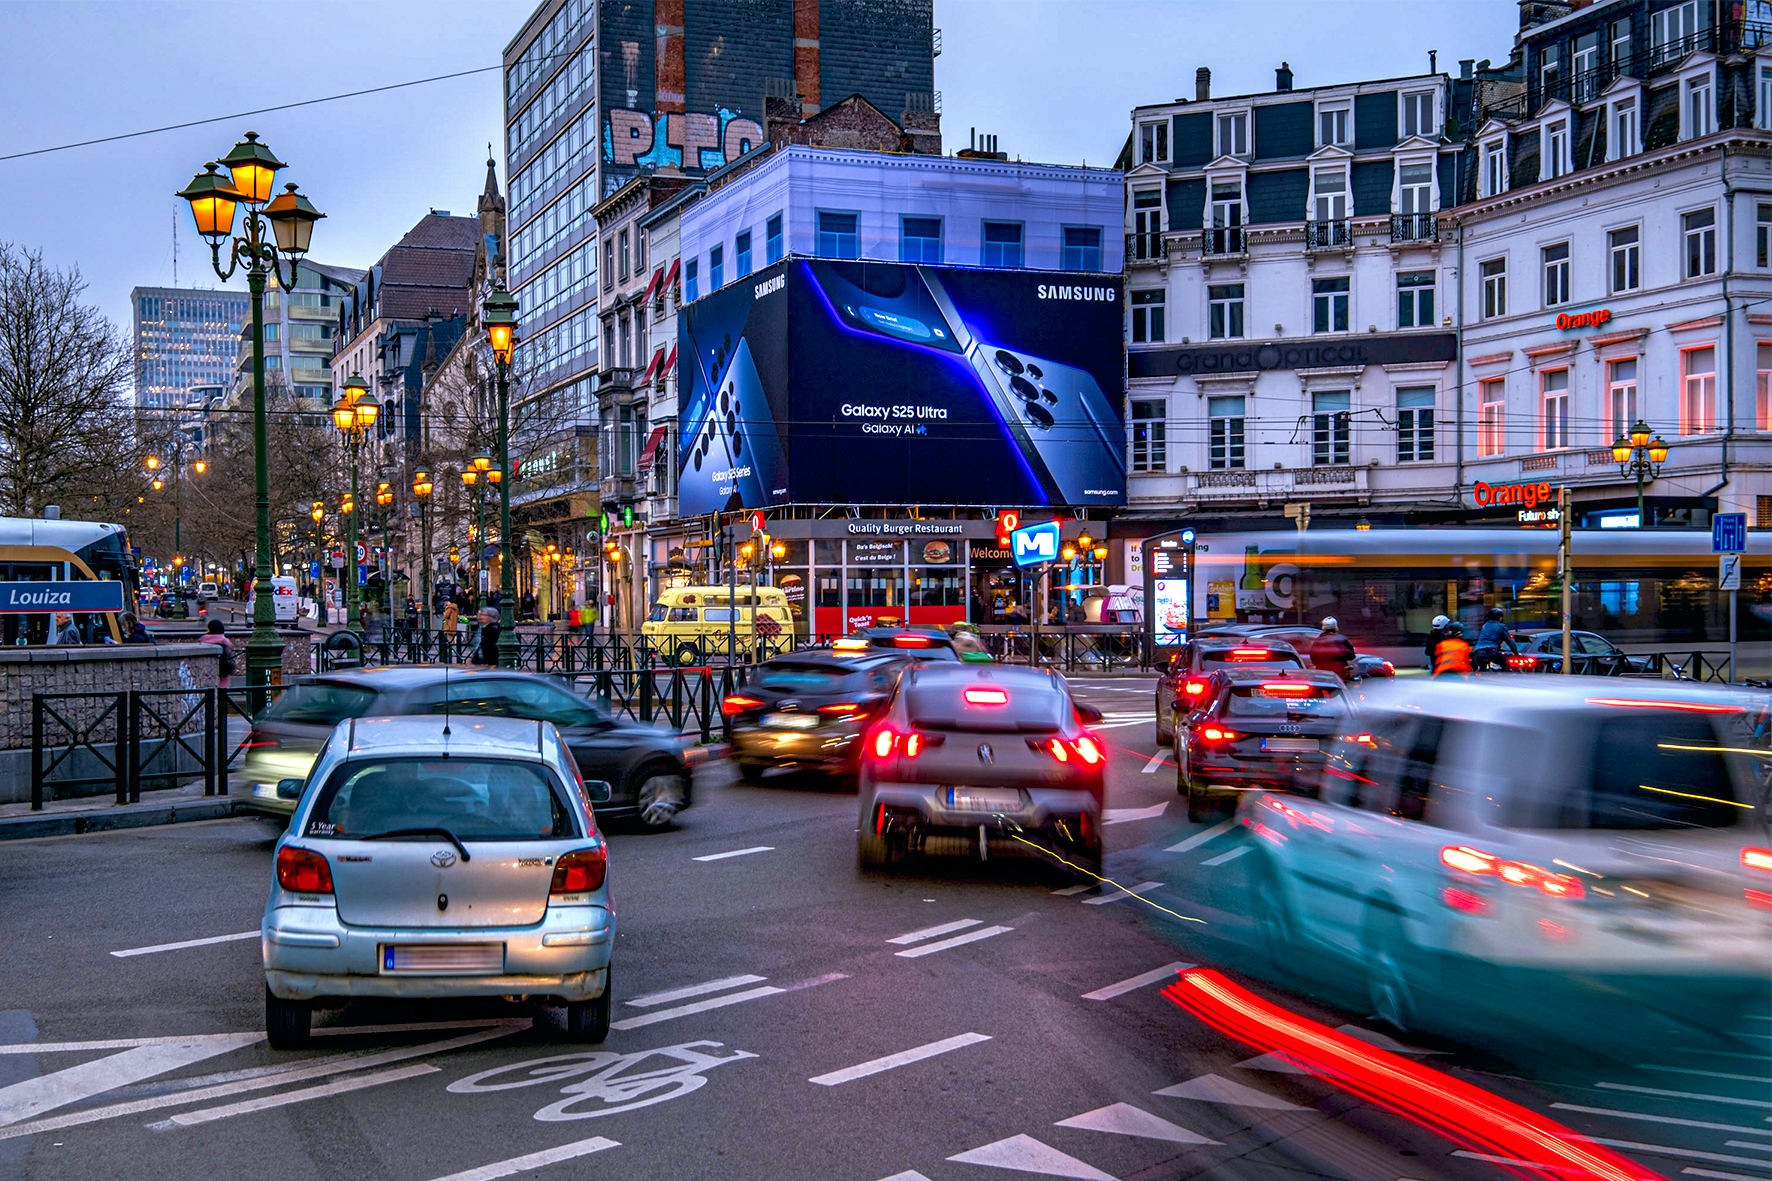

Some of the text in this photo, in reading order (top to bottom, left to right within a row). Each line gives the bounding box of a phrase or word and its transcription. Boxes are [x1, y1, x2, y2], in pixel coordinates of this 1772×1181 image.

[755, 273, 785, 300] SAMSUNG
[1037, 284, 1115, 302] SAMSUNG
[1556, 308, 1610, 330] Orange
[841, 403, 948, 420] Galaxy S25 Ultra
[862, 422, 914, 437] Galaxy AI
[711, 471, 728, 482] Galaxy
[736, 465, 751, 478] Series
[1084, 489, 1119, 497] samsung.com
[1474, 481, 1551, 509] Orange
[848, 523, 963, 535] Quality Burger Restaurant
[1003, 514, 1017, 532] Q
[1017, 532, 1055, 556] M
[1195, 543, 1209, 552] ing
[1131, 564, 1144, 572] Dri
[9, 588, 71, 605] Louiza
[272, 586, 293, 596] dEx
[318, 821, 336, 830] Year
